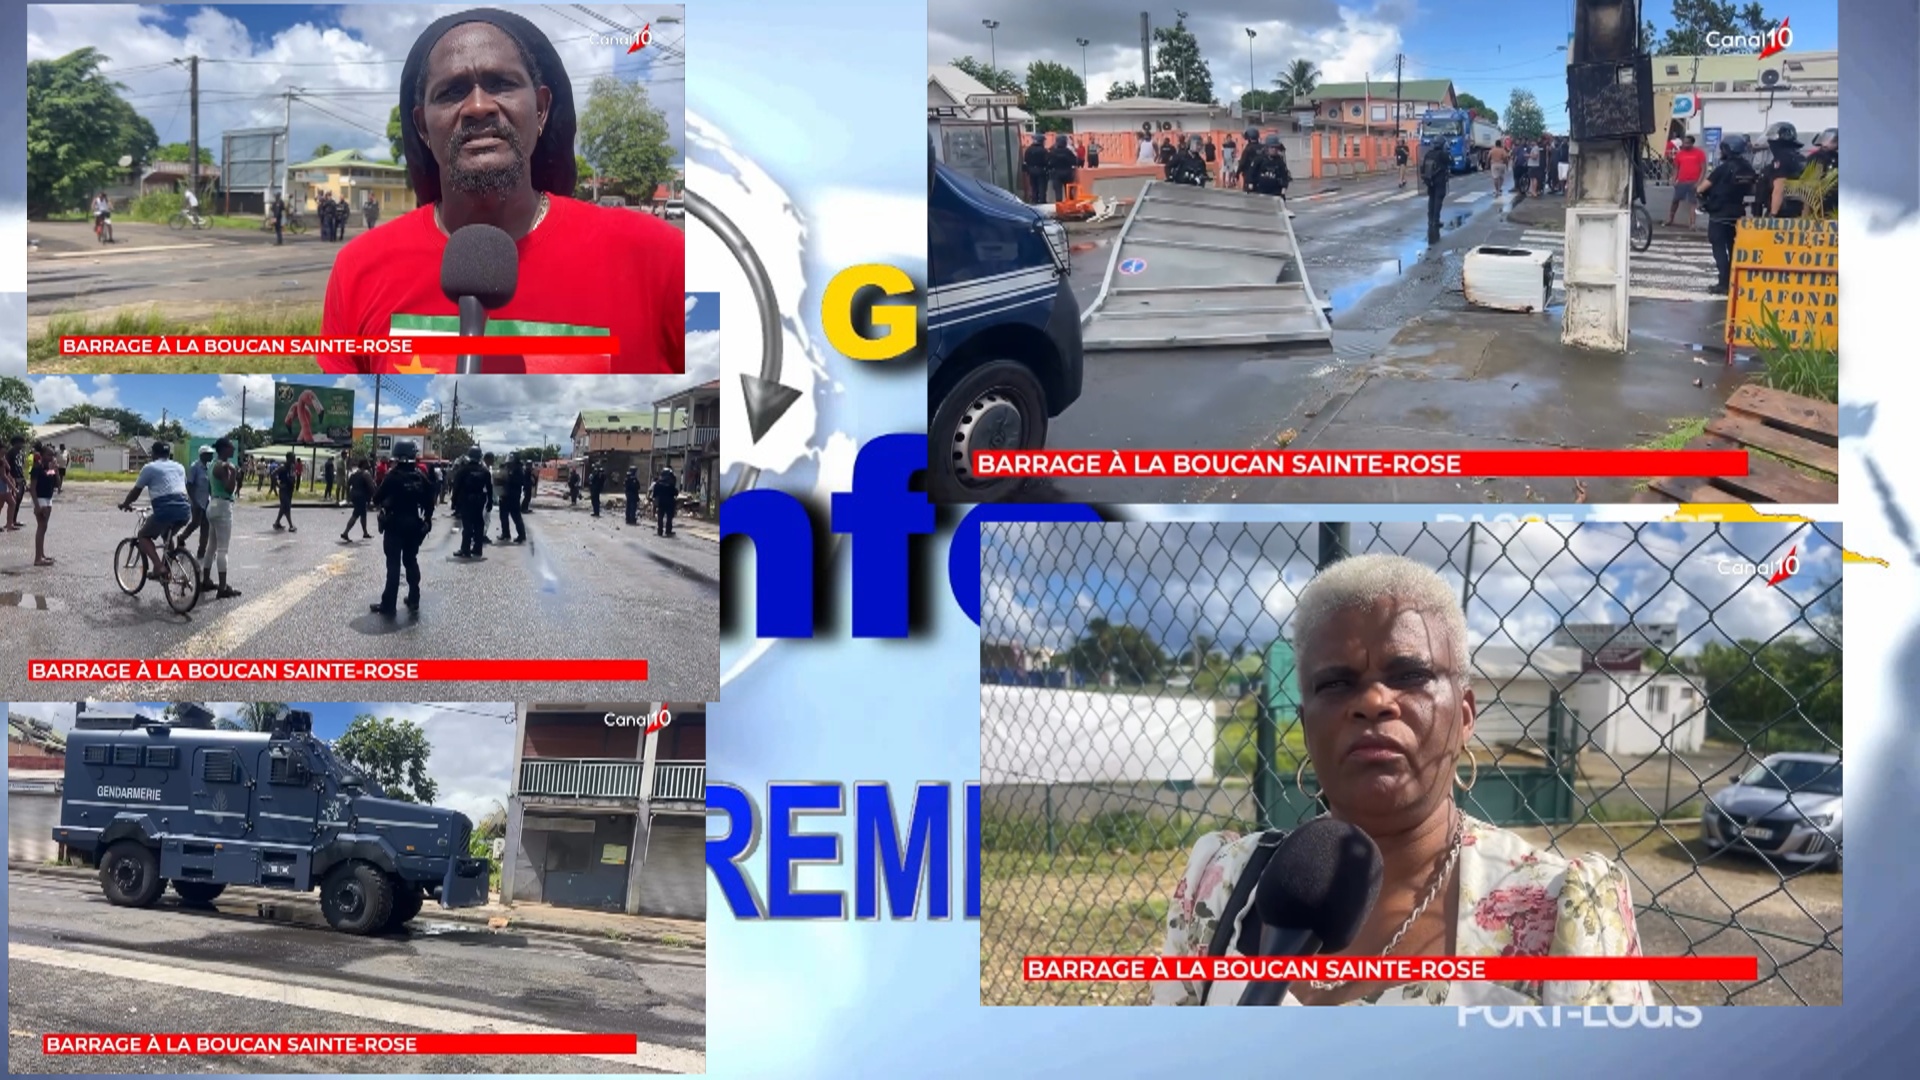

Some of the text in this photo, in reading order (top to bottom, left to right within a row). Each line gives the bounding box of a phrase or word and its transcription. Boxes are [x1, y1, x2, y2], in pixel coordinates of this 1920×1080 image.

[1736, 248, 1764, 264] DE
[1747, 270, 1838, 287] PORTIE
[97, 785, 162, 801] GENDARMERIE
